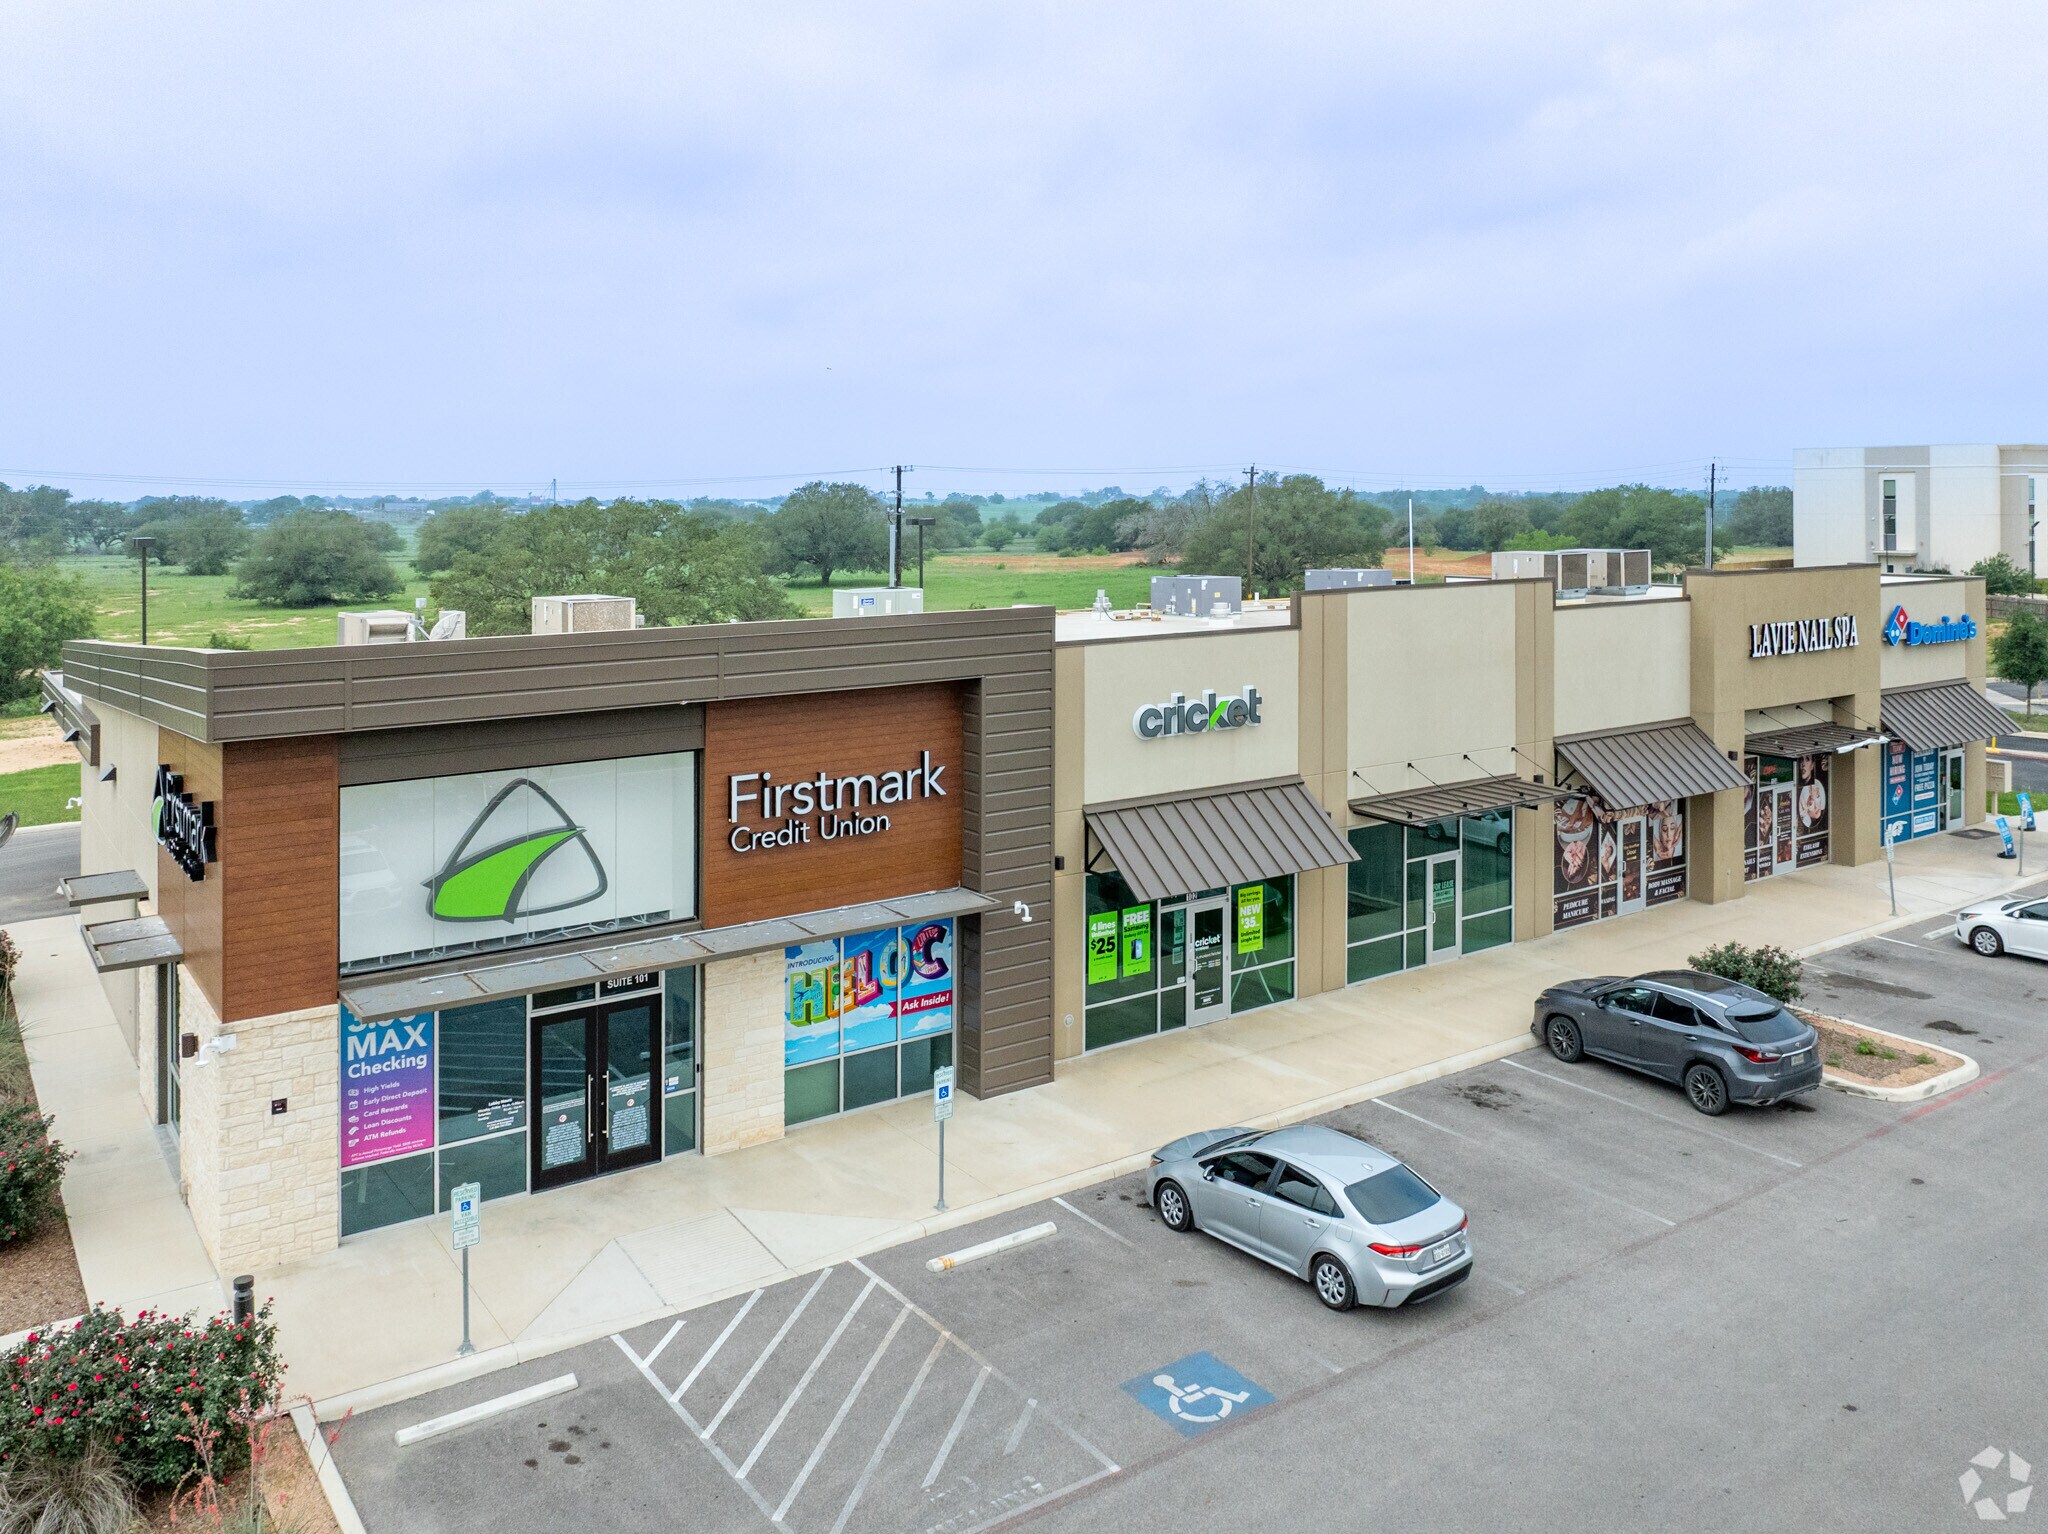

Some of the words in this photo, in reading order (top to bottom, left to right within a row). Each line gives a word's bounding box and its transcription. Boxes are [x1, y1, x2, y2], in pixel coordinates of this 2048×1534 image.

[1797, 618, 1833, 653] NAIL
[1833, 615, 1860, 649] SPA
[1906, 614, 1976, 645] Domino's
[1133, 685, 1262, 740] cricket
[728, 751, 947, 823] Firstmark
[730, 820, 810, 852] Credit
[818, 812, 890, 840] Union
[1442, 880, 1454, 890] LEASE
[1240, 903, 1261, 916] NEW
[1563, 898, 1589, 910] PEDICURE
[1124, 910, 1149, 927] FREE
[1562, 907, 1589, 919] MANICURE
[1091, 929, 1116, 938] Unlimited
[1092, 923, 1097, 931] 4
[1098, 921, 1116, 931] lines
[1124, 924, 1149, 933] Samsung
[1091, 936, 1116, 955] $25
[1195, 934, 1221, 947] cricket
[787, 955, 835, 969] INTRODUCING
[607, 976, 633, 989] SUITE
[635, 973, 649, 984] 101
[790, 924, 949, 1028] HELOC
[902, 1000, 919, 1011] Ask
[921, 993, 949, 1007] Inside!
[347, 1022, 428, 1061] MAX
[348, 1054, 428, 1079] Checking
[363, 1085, 379, 1094] High
[380, 1081, 400, 1090] Yields
[363, 1097, 380, 1106] Early
[381, 1093, 401, 1102] Direct
[402, 1087, 428, 1098] Deposit
[363, 1108, 380, 1118] Card
[380, 1103, 408, 1114] Rewards
[363, 1122, 380, 1130] Loan
[381, 1115, 412, 1126] Discounts
[363, 1133, 379, 1142] ATM
[380, 1127, 407, 1138] Refunds
